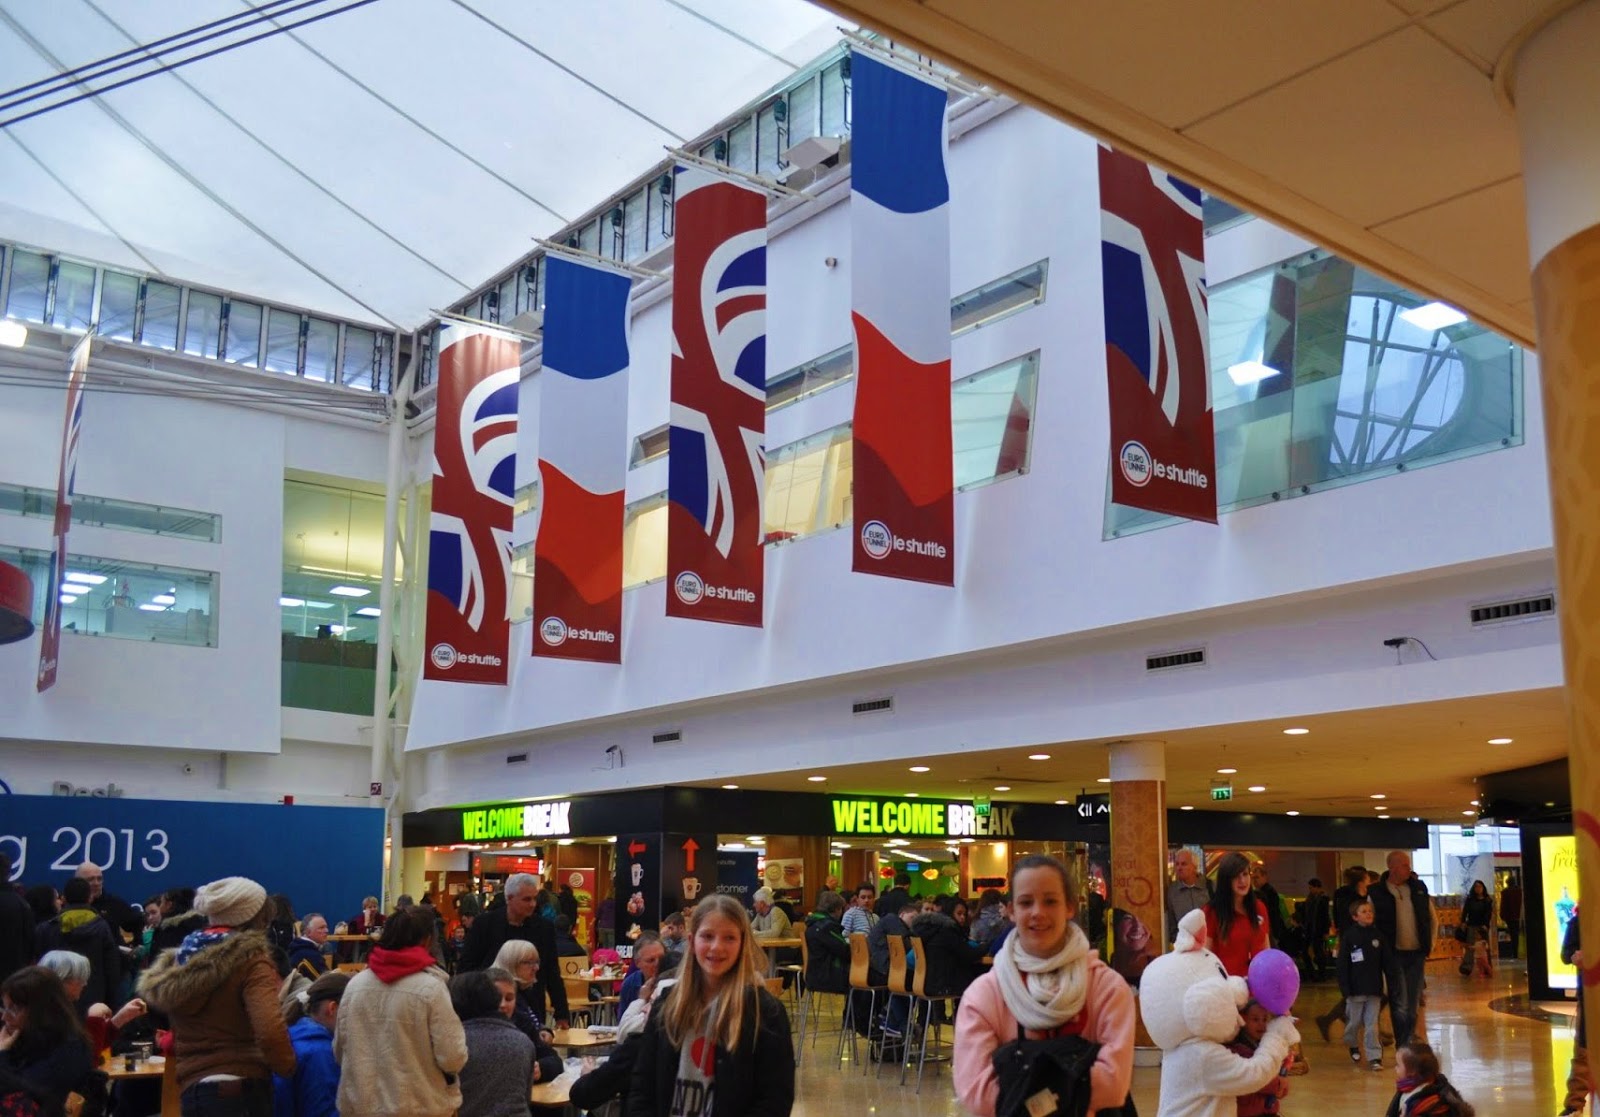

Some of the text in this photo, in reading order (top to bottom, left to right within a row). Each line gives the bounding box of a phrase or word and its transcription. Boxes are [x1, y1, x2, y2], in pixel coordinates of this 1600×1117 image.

[1127, 452, 1144, 464] EURO
[1125, 460, 1147, 473] TUNNEL
[1153, 458, 1208, 489] le shuttle
[868, 530, 884, 540] EURO
[865, 537, 888, 548] TUNNEL
[893, 535, 947, 559] le shuttle
[679, 585, 699, 595] TUNNEL
[681, 579, 697, 587] EURO
[704, 583, 755, 602] le shuttle
[567, 626, 615, 643] le shuttle
[457, 651, 502, 667] le shuttle
[832, 800, 1015, 836] WELCOME BREAK
[50, 826, 171, 872] 2013
[716, 884, 749, 894] stomer
